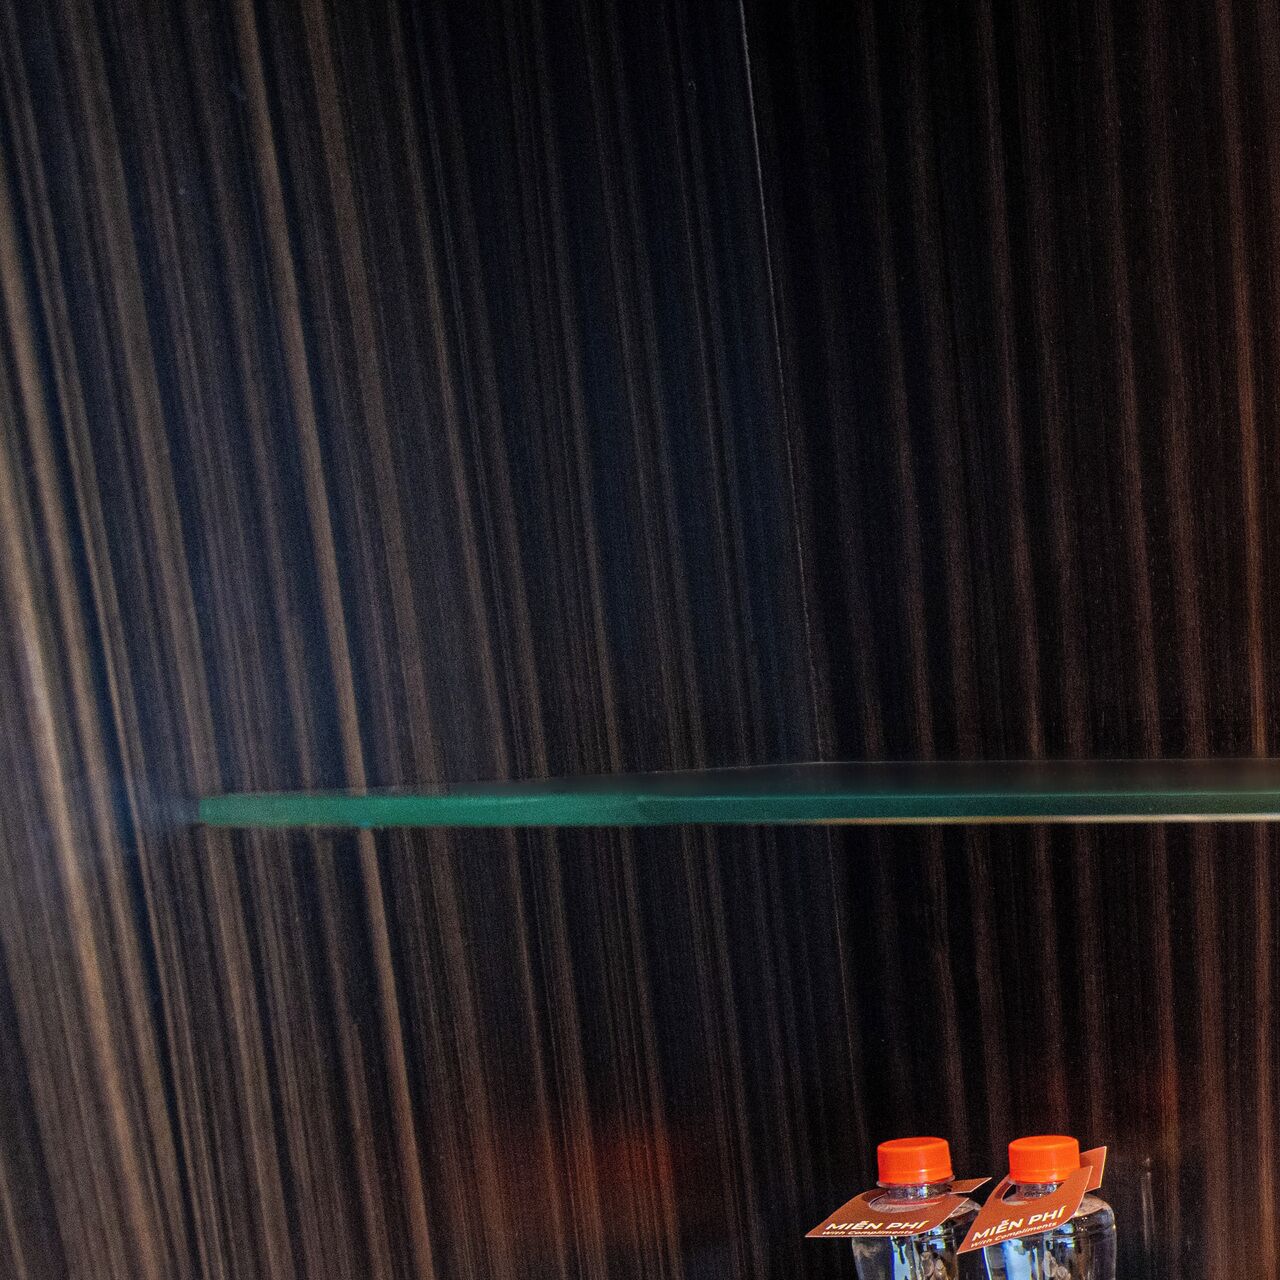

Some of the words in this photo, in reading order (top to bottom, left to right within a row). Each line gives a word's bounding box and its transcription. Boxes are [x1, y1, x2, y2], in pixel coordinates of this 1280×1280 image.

[886, 1220, 929, 1230] PHÍ
[1028, 1205, 1067, 1225] PHÍ
[970, 1238, 993, 1248] With
[995, 1222, 1058, 1241] Compliments
